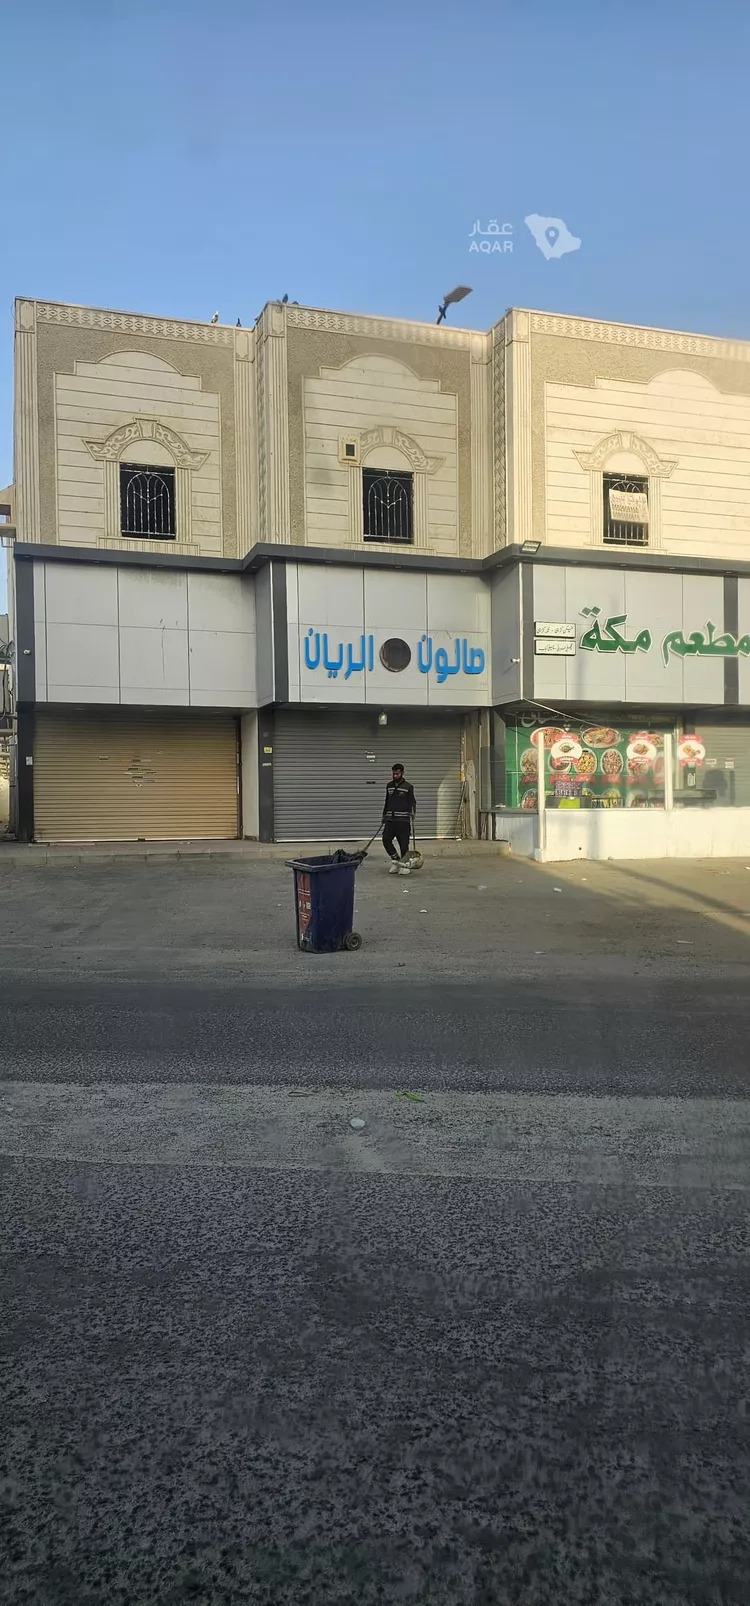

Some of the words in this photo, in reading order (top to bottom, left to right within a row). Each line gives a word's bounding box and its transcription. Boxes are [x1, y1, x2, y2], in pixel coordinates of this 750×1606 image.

[304, 627, 374, 680] الريان
[578, 605, 653, 654] مكة
[661, 619, 750, 668] مطعم
[417, 634, 486, 683] صالون
